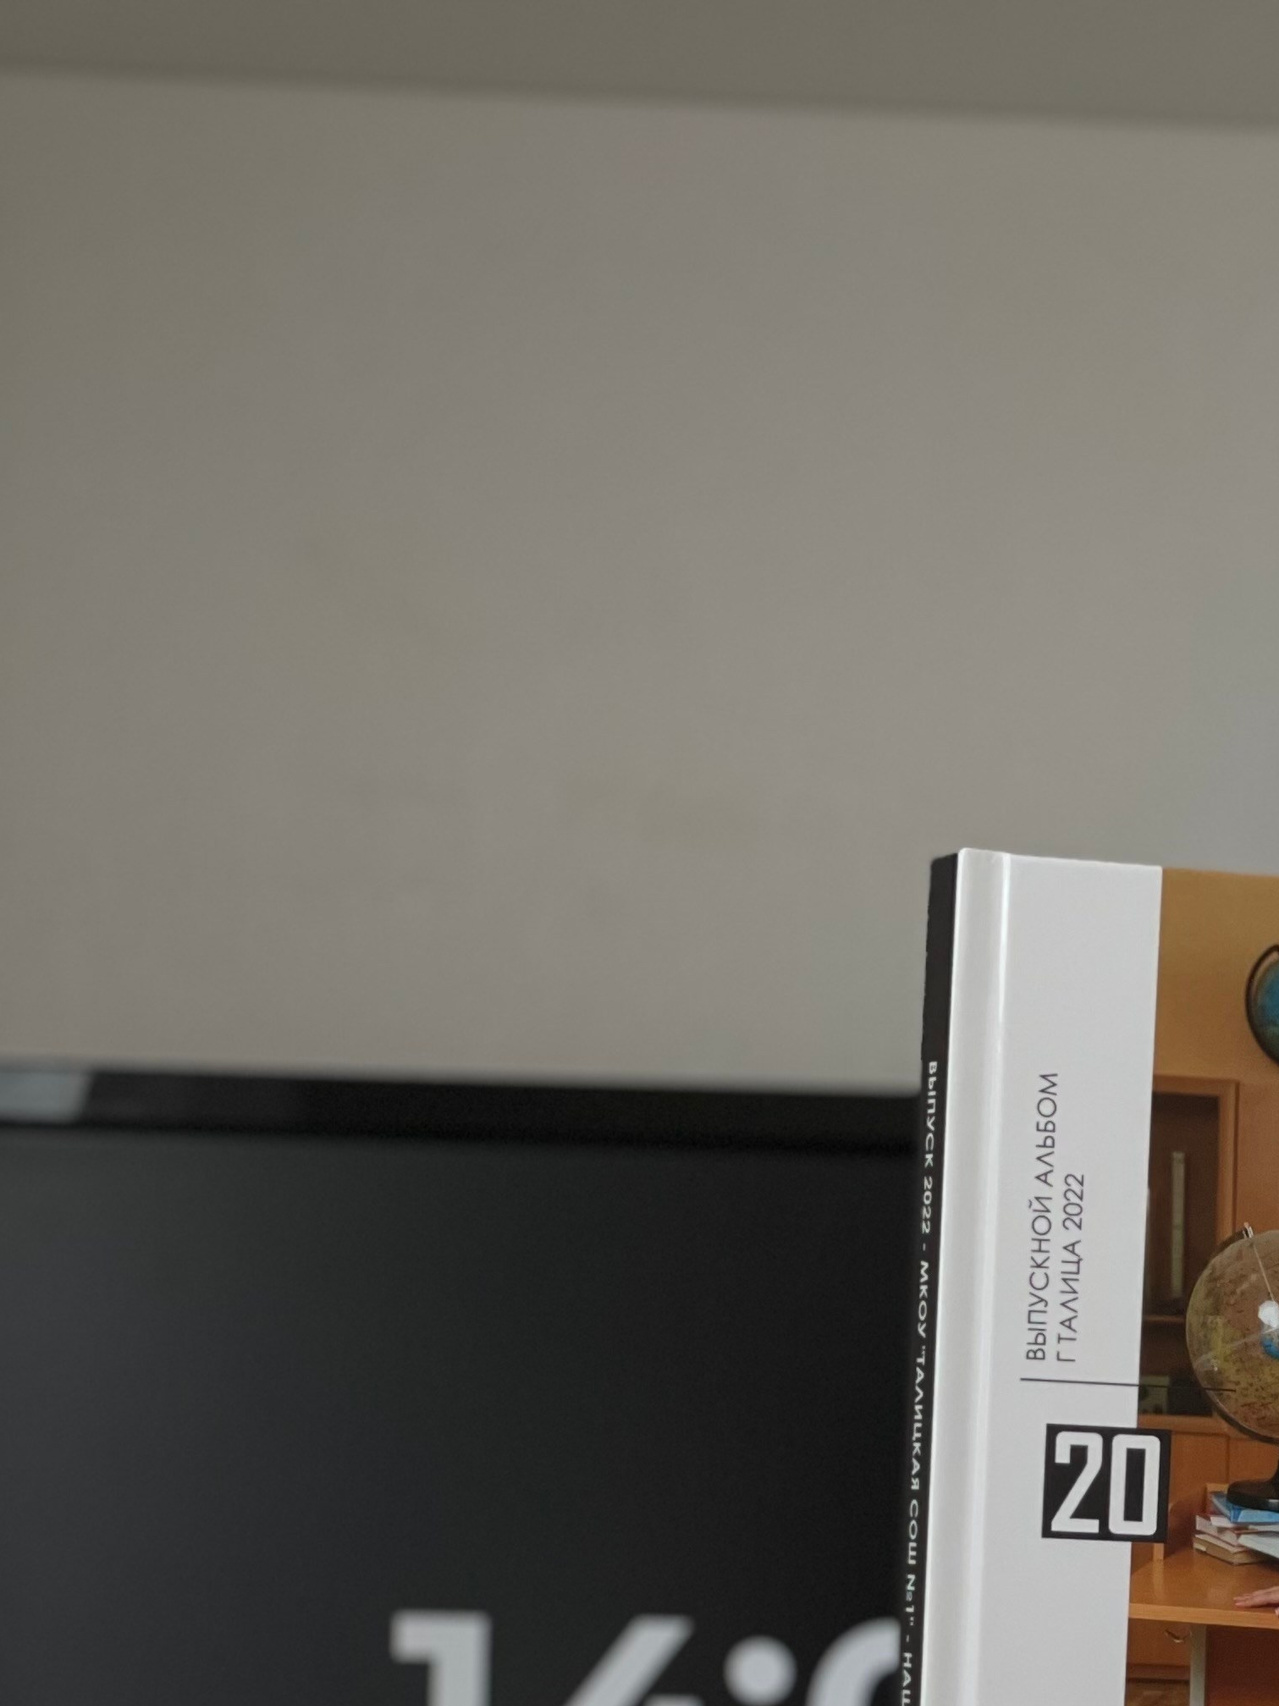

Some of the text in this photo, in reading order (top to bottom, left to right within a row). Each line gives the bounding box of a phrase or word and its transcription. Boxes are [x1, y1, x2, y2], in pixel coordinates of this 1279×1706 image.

[924, 1061, 937, 1167] ВЫПУСК
[922, 1176, 933, 1233] 2022
[1025, 1073, 1058, 1361] ВЫПУСКНОЙ АЛЬБОМ
[918, 1260, 929, 1338] МКОУ
[1056, 1173, 1085, 1363] Г ТАЛИЦА 2022
[907, 1499, 919, 1565] СОШ
[1050, 1430, 1161, 1537] 20
